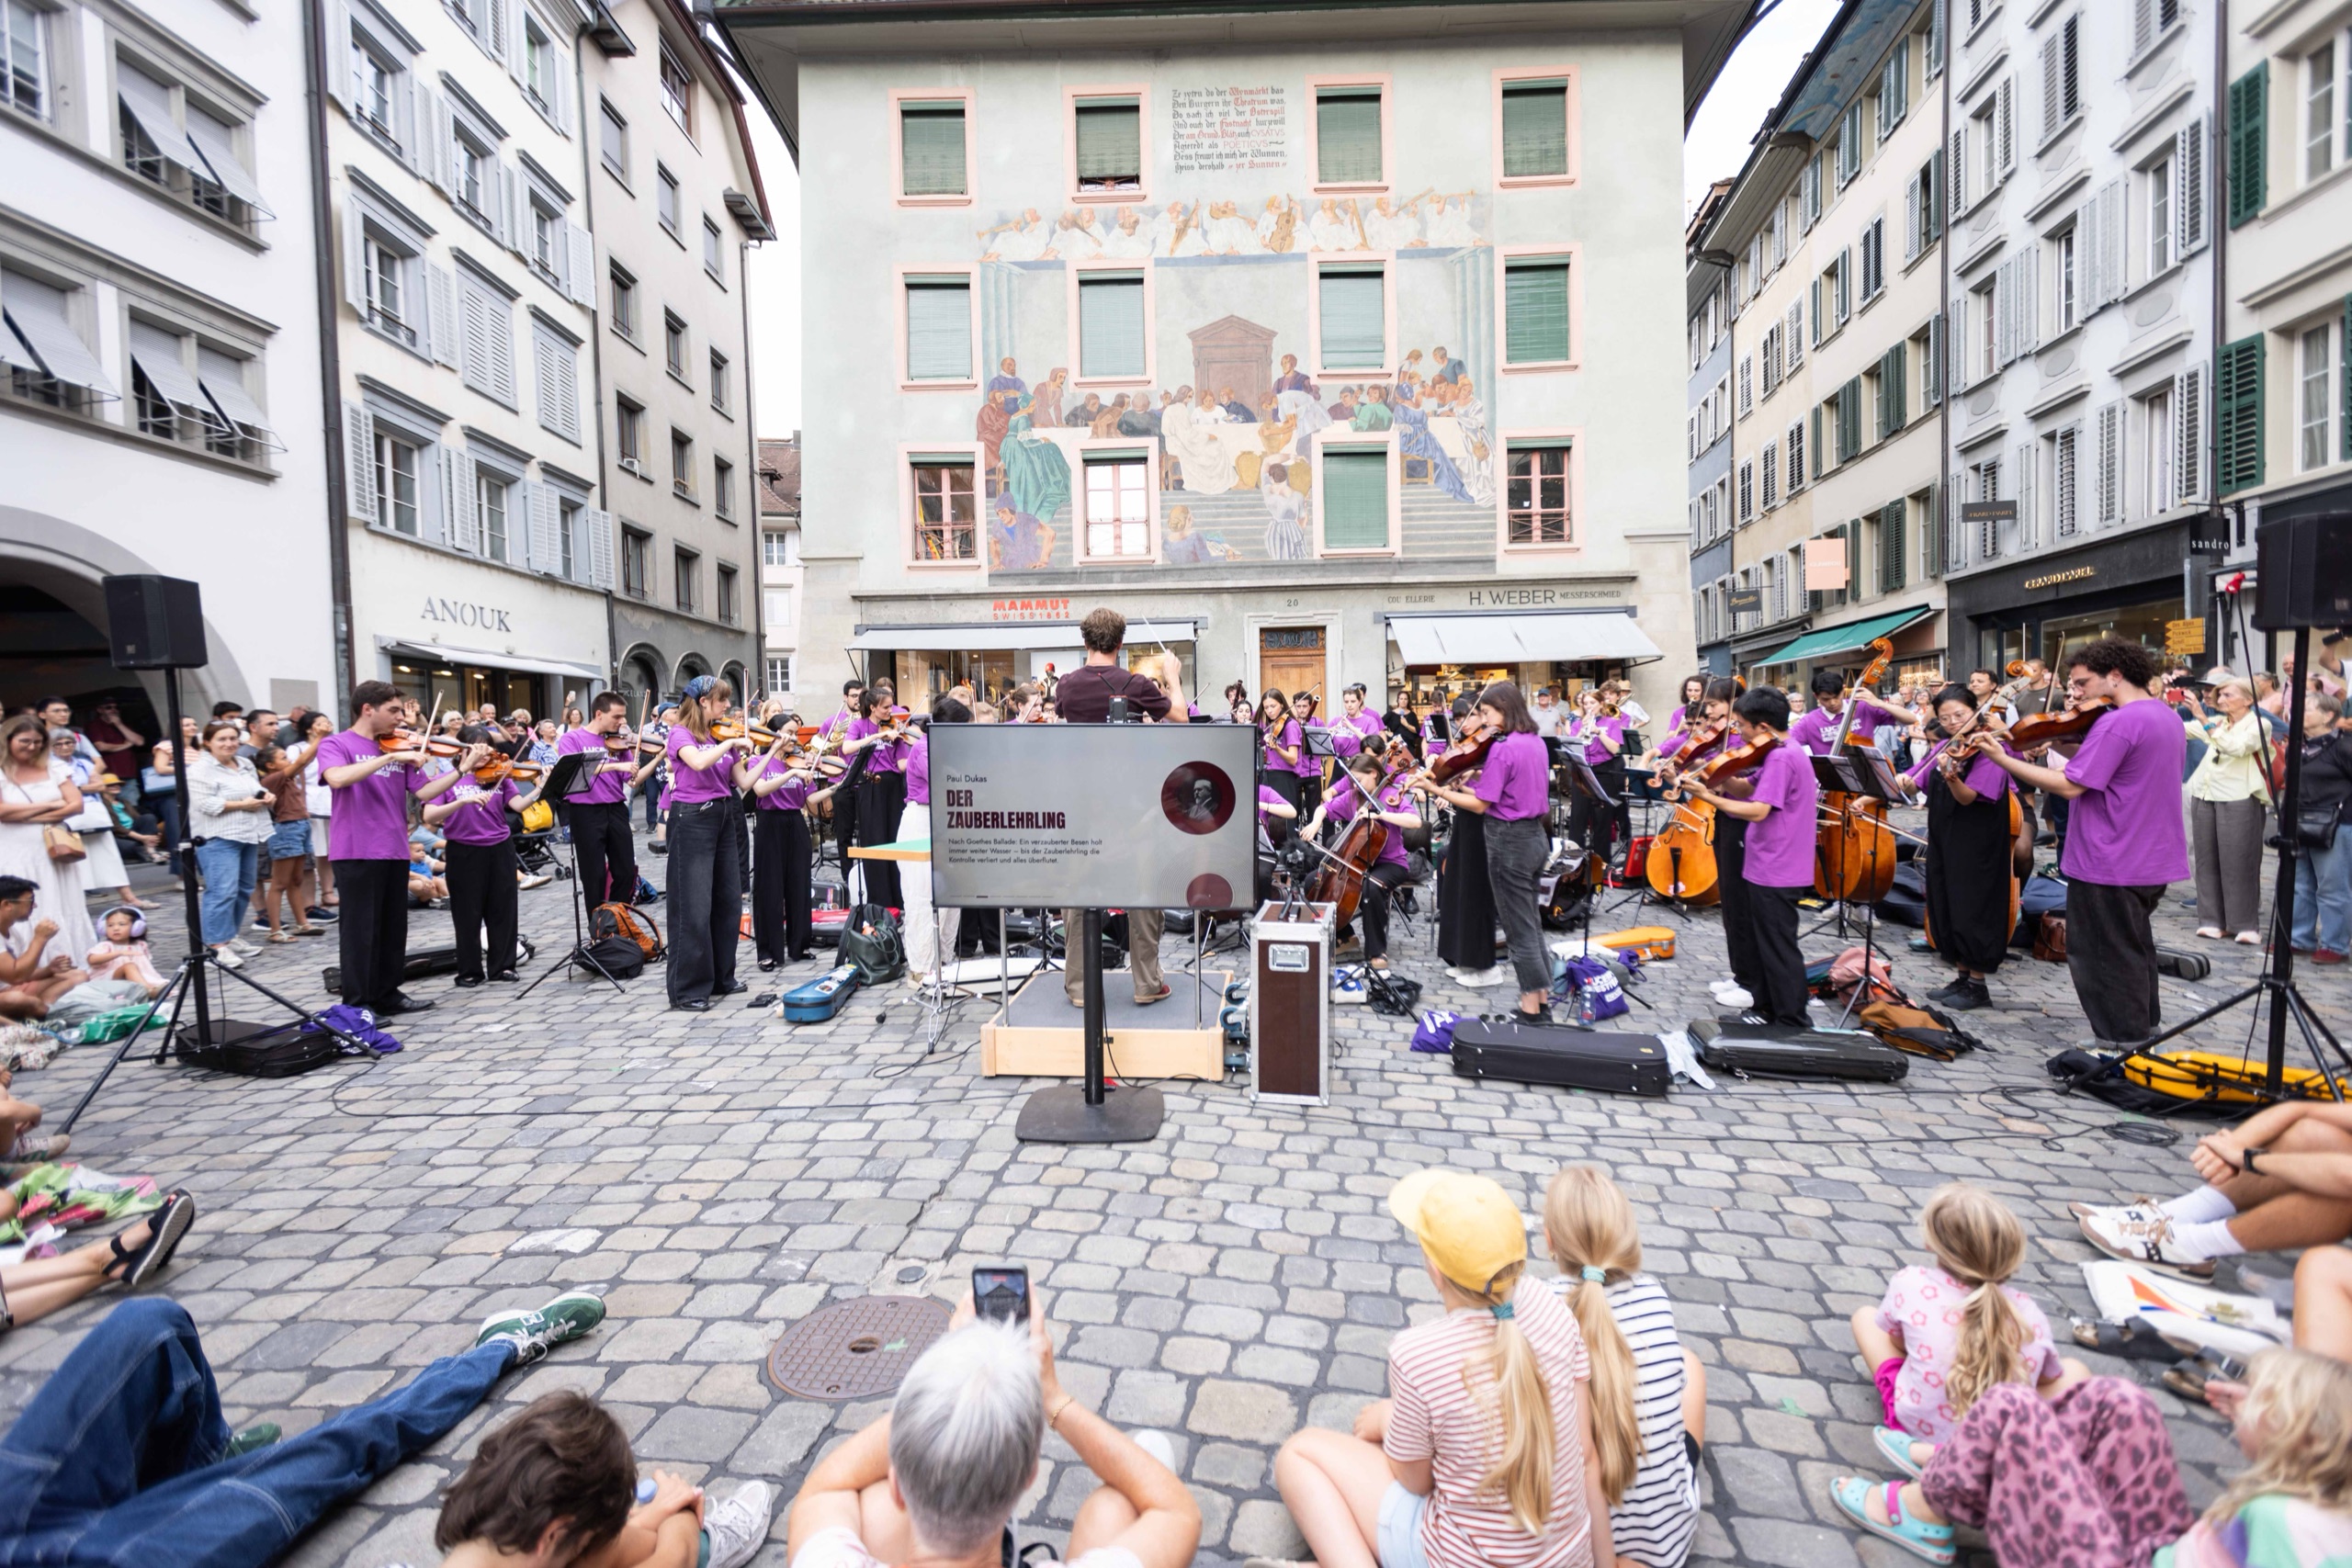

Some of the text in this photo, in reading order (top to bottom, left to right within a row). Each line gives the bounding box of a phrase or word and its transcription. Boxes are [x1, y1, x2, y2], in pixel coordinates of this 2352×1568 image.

[1234, 97, 1268, 106] Theatrum
[1205, 110, 1214, 118] ich
[1219, 109, 1230, 117] viel
[1234, 107, 1246, 116] der
[1205, 119, 1216, 128] der
[1238, 149, 1248, 158] der
[2192, 539, 2229, 549] sandro
[1470, 589, 1621, 605] H. WEBER MESSERSCHMIED
[993, 598, 1070, 611] MAMMUT
[1287, 598, 1299, 607] 20
[421, 596, 511, 632] ANOUK
[946, 774, 987, 783] Paul Dukas
[946, 789, 973, 807] DER
[947, 811, 1066, 829] ZAUBERLEHRLING
[1044, 847, 1088, 856] Zauberlehrling
